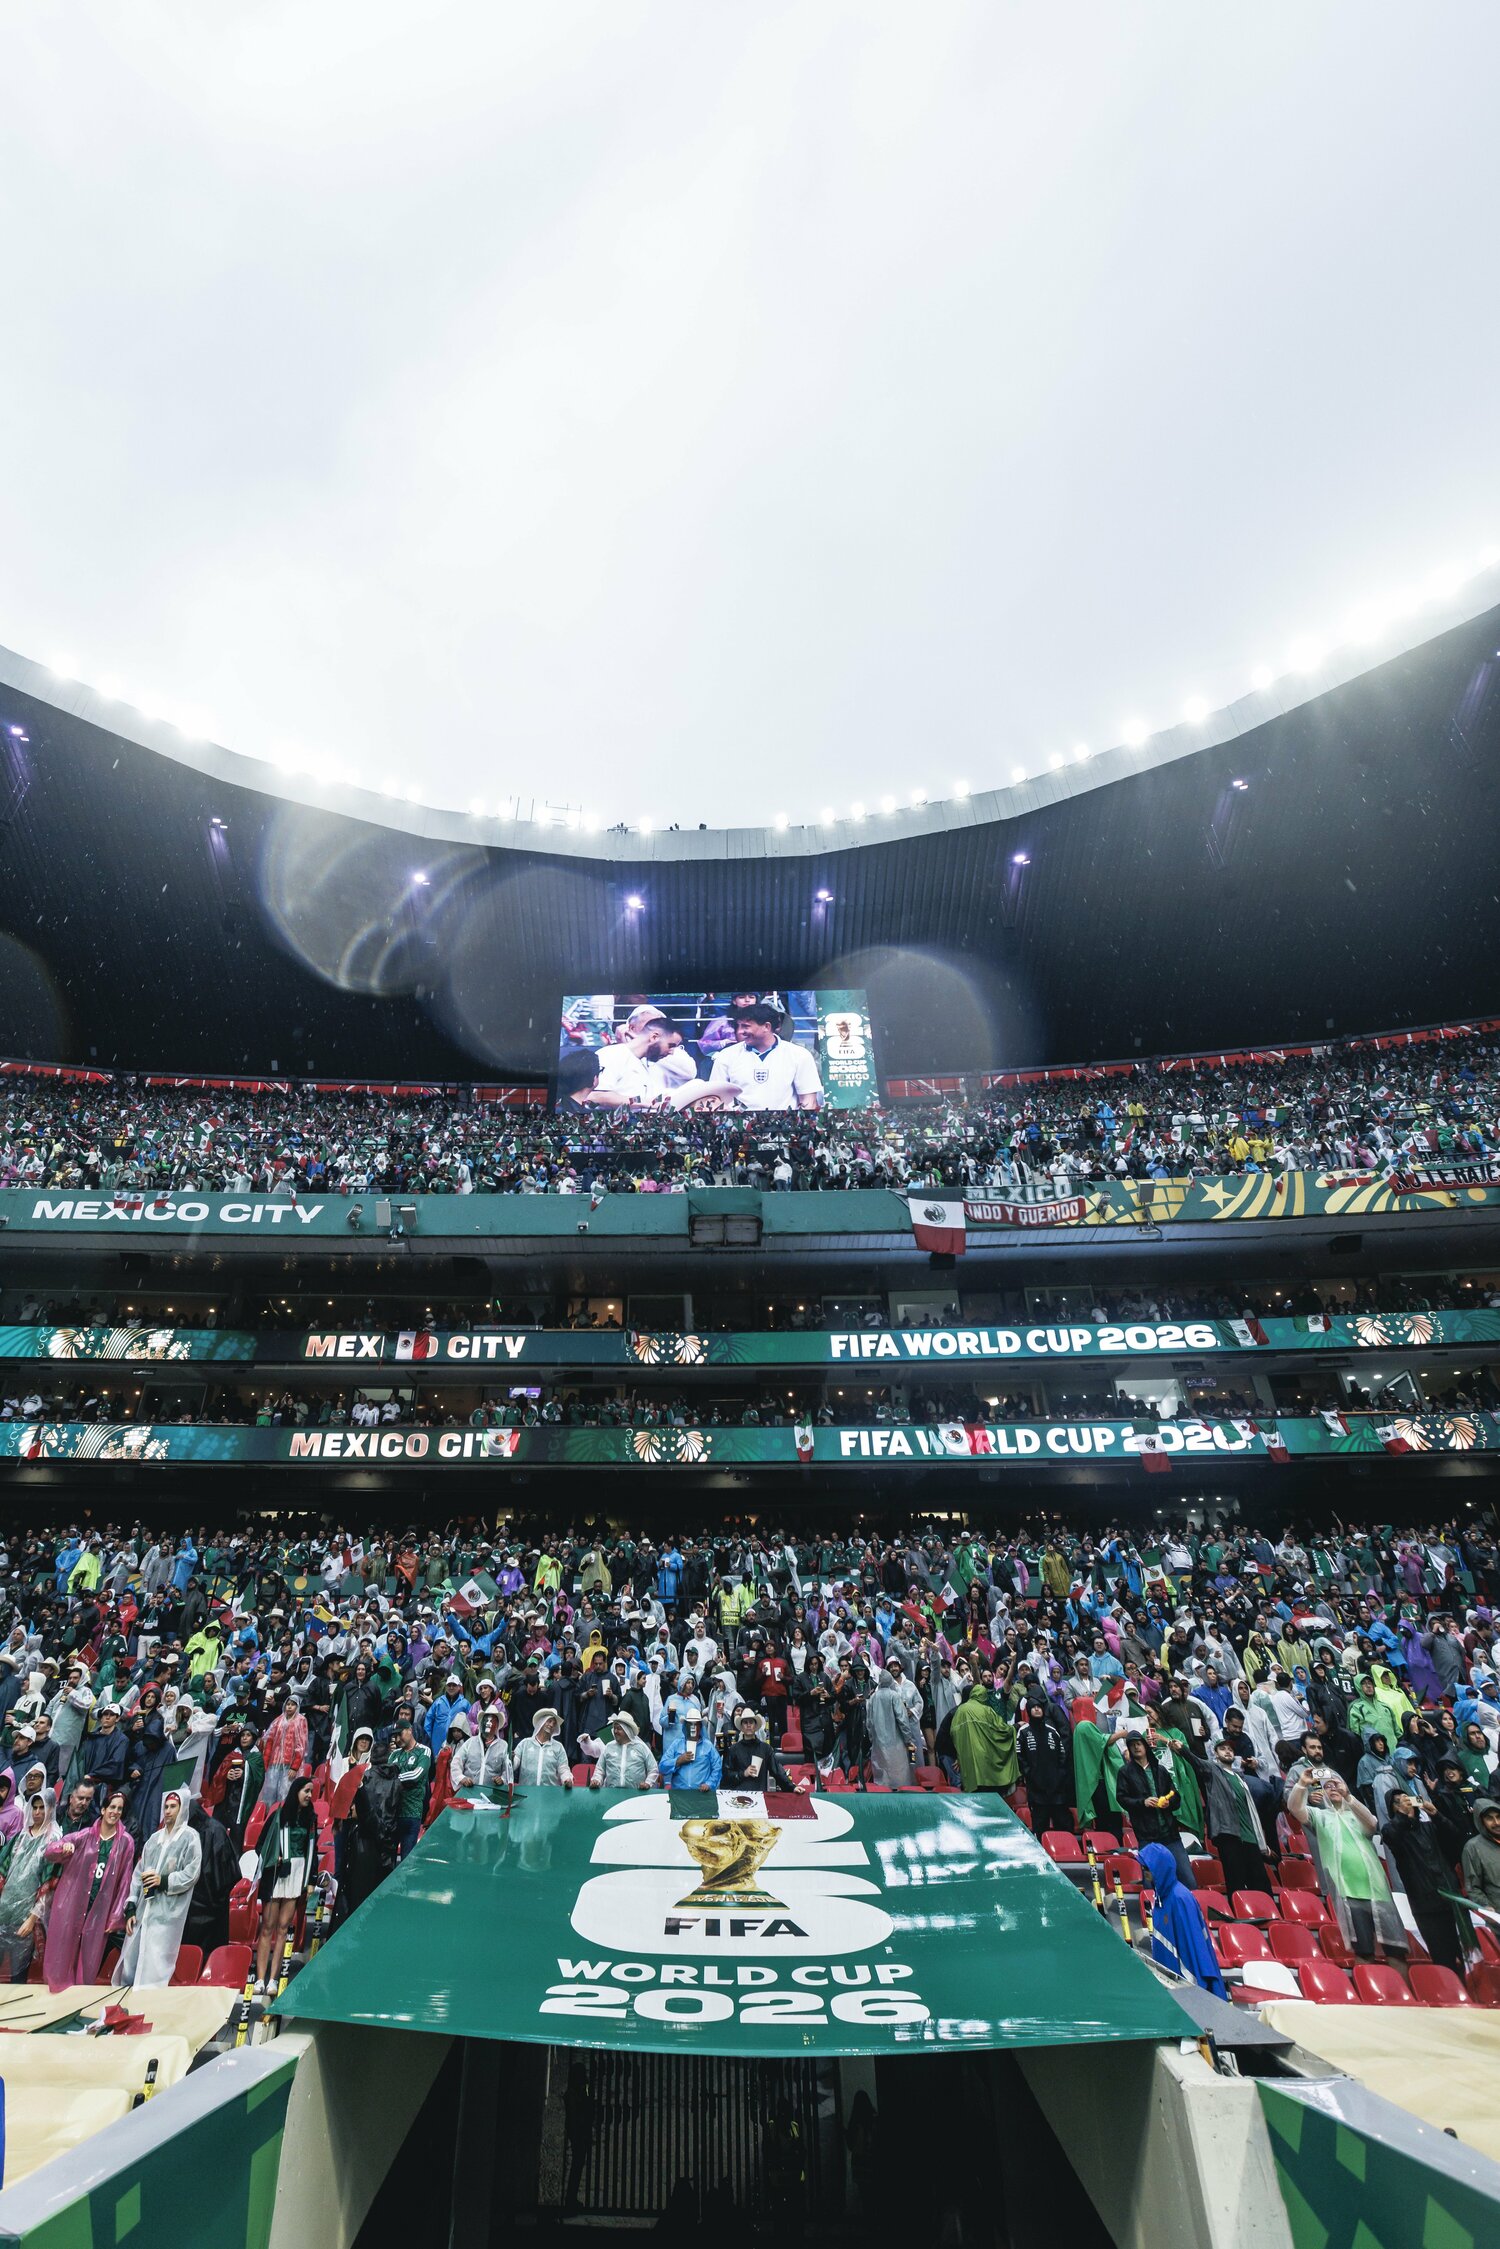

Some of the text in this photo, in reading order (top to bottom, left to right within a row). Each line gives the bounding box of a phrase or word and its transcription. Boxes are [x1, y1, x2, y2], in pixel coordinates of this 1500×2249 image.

[1452, 1162, 1500, 1184] RAJE
[219, 1203, 324, 1224] CITY
[964, 1202, 1079, 1225] INDO Y QUERIDO
[447, 1335, 526, 1358] CITY
[830, 1324, 1216, 1358] FIFA WORLD CUP 2026
[289, 1432, 430, 1458] MEXICO
[840, 1430, 913, 1456] FIFA
[1046, 1427, 1115, 1453] CUP
[664, 1917, 810, 1937] FIFA
[557, 1958, 913, 1985] WORLD CUP
[240, 2001, 251, 2021] 141
[539, 1984, 930, 2025] 2026
